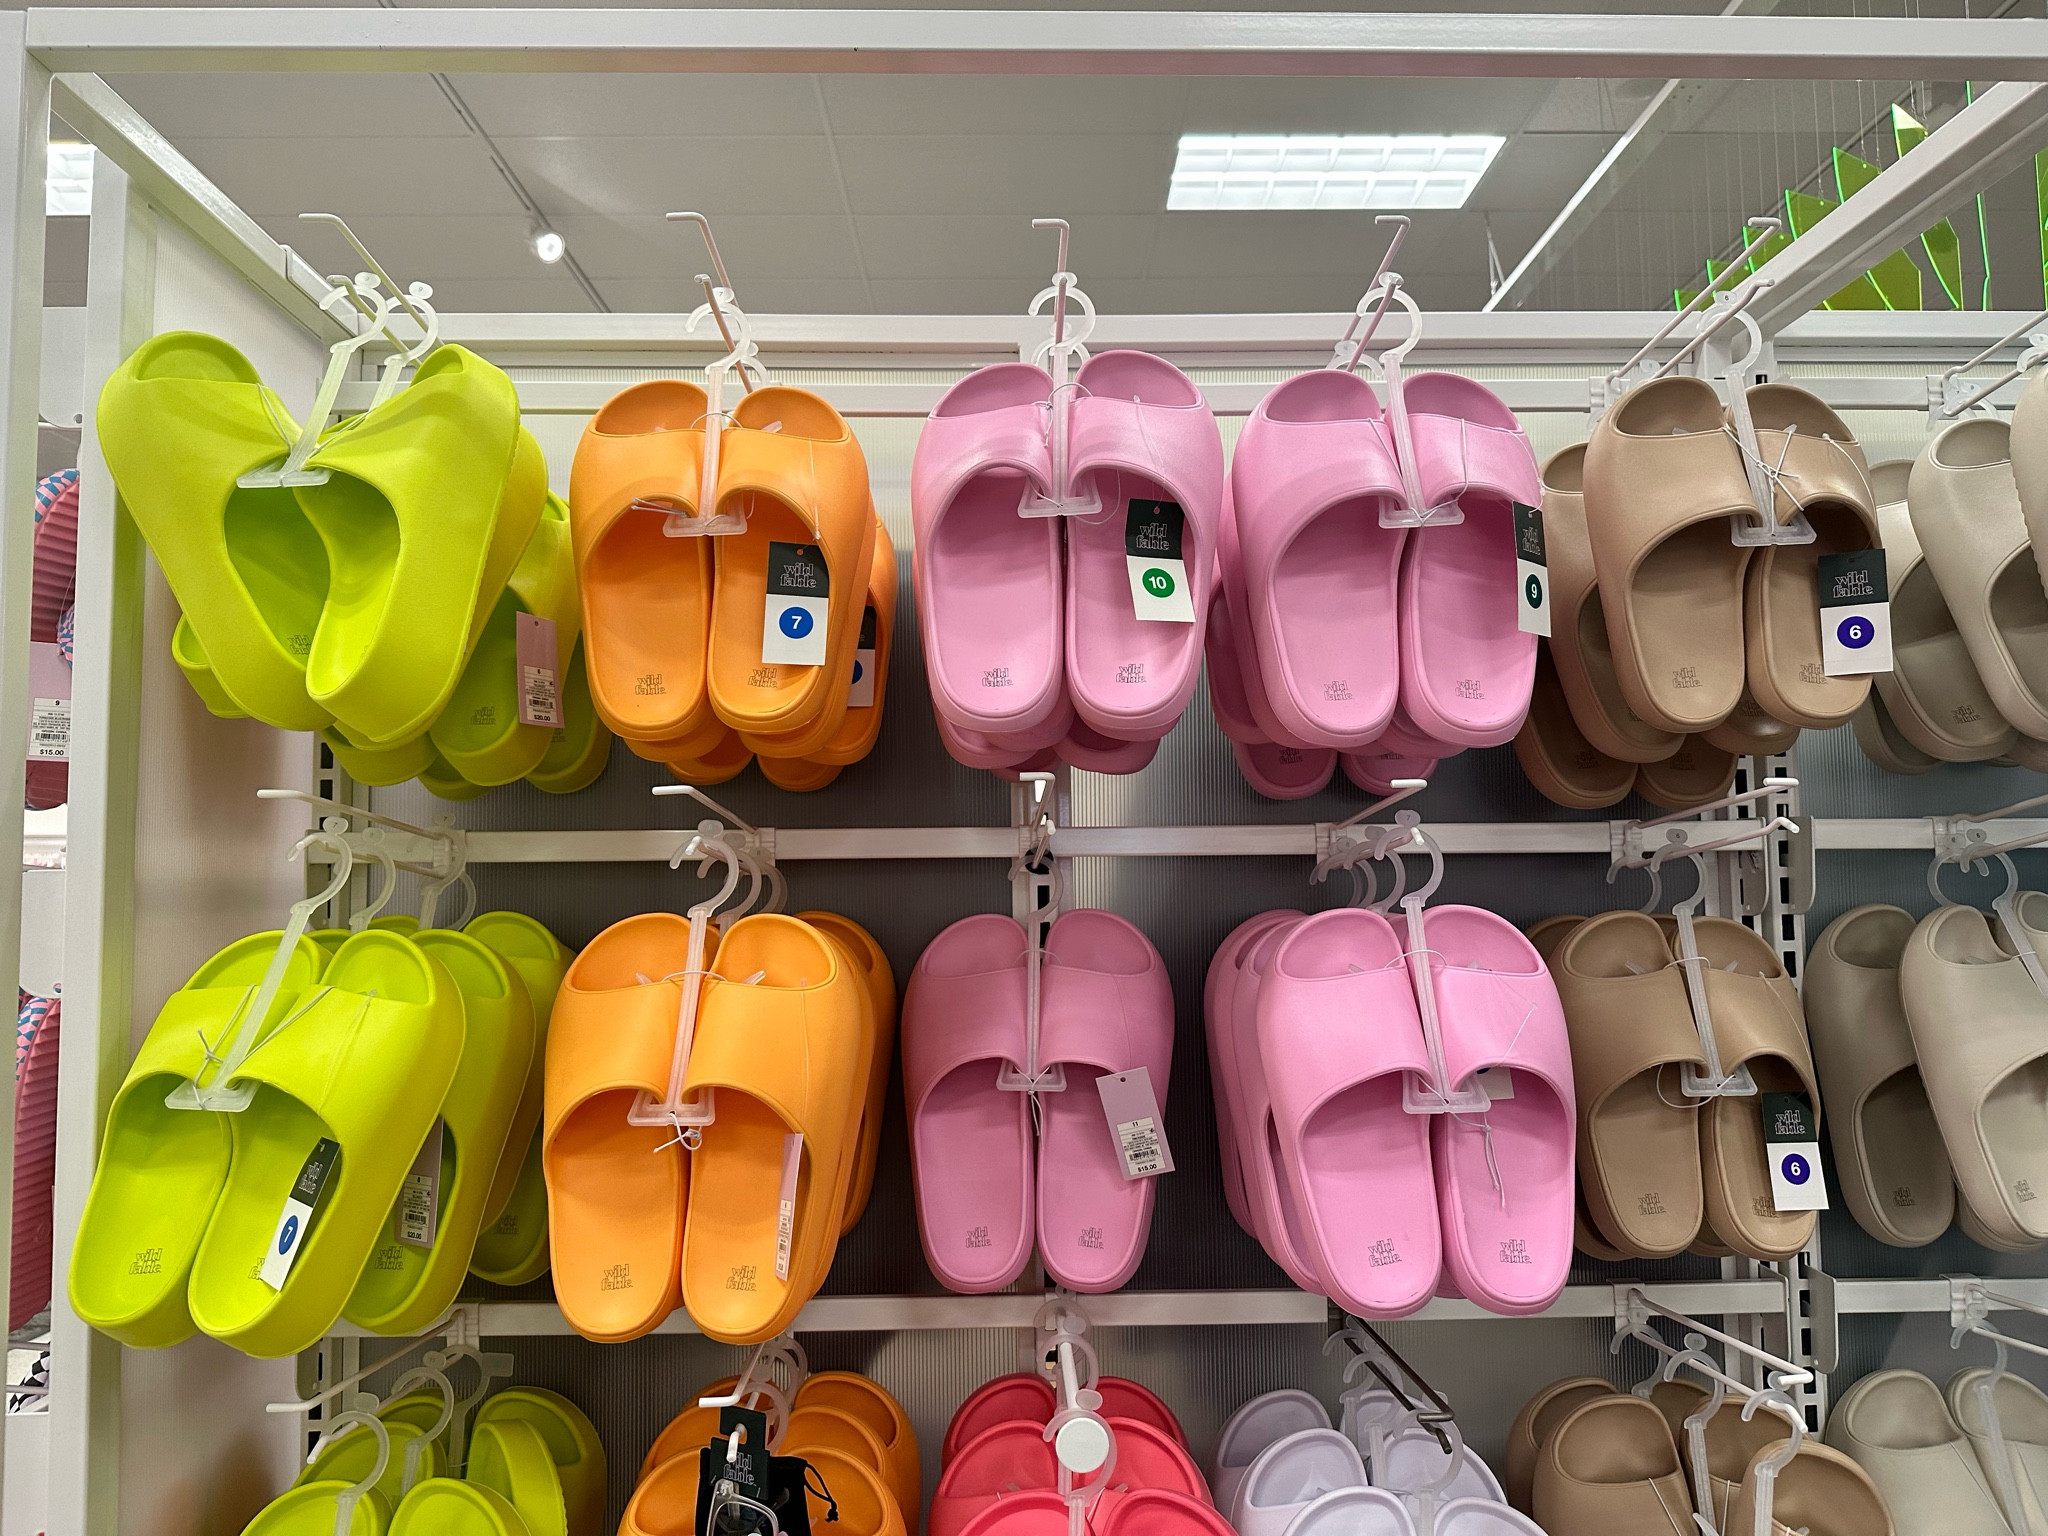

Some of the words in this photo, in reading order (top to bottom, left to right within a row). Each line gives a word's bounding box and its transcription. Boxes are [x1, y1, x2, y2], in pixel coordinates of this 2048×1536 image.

[1140, 523, 1167, 537] wild
[1136, 535, 1170, 550] fable
[784, 562, 815, 576] wild
[780, 573, 817, 589] fable
[1149, 576, 1167, 590] 10
[1834, 570, 1869, 585] wild
[1531, 583, 1538, 599] 9
[1832, 584, 1874, 599] fable
[791, 615, 802, 630] 7
[1849, 625, 1862, 640] 6
[753, 668, 777, 679] wild
[986, 668, 1010, 678] wild
[1119, 664, 1144, 674] wild
[1672, 667, 1697, 679] wild
[637, 674, 663, 685] wild
[748, 676, 778, 688] fable
[982, 677, 1012, 688] fable
[1115, 673, 1146, 684] fable
[1672, 678, 1701, 689] fable
[635, 684, 665, 696] fable
[533, 714, 551, 722] $20.00
[1775, 1109, 1801, 1123] wild
[1774, 1121, 1806, 1135] fable
[1137, 1163, 1158, 1172] $15.00
[1791, 1162, 1801, 1176] 6
[284, 1225, 293, 1243] 7
[379, 1246, 404, 1259] wild
[1368, 1239, 1395, 1254] wild
[1500, 1239, 1526, 1252] wild
[136, 1248, 163, 1262] wild
[1368, 1250, 1402, 1267] fable
[1500, 1250, 1532, 1264] fable
[129, 1262, 162, 1275] fable
[374, 1258, 404, 1270] fable
[604, 1264, 630, 1278] wild
[731, 1265, 757, 1279] wild
[601, 1276, 633, 1291] fable
[726, 1276, 757, 1291] fable
[731, 1451, 753, 1471] ild
[723, 1464, 755, 1486] fable
